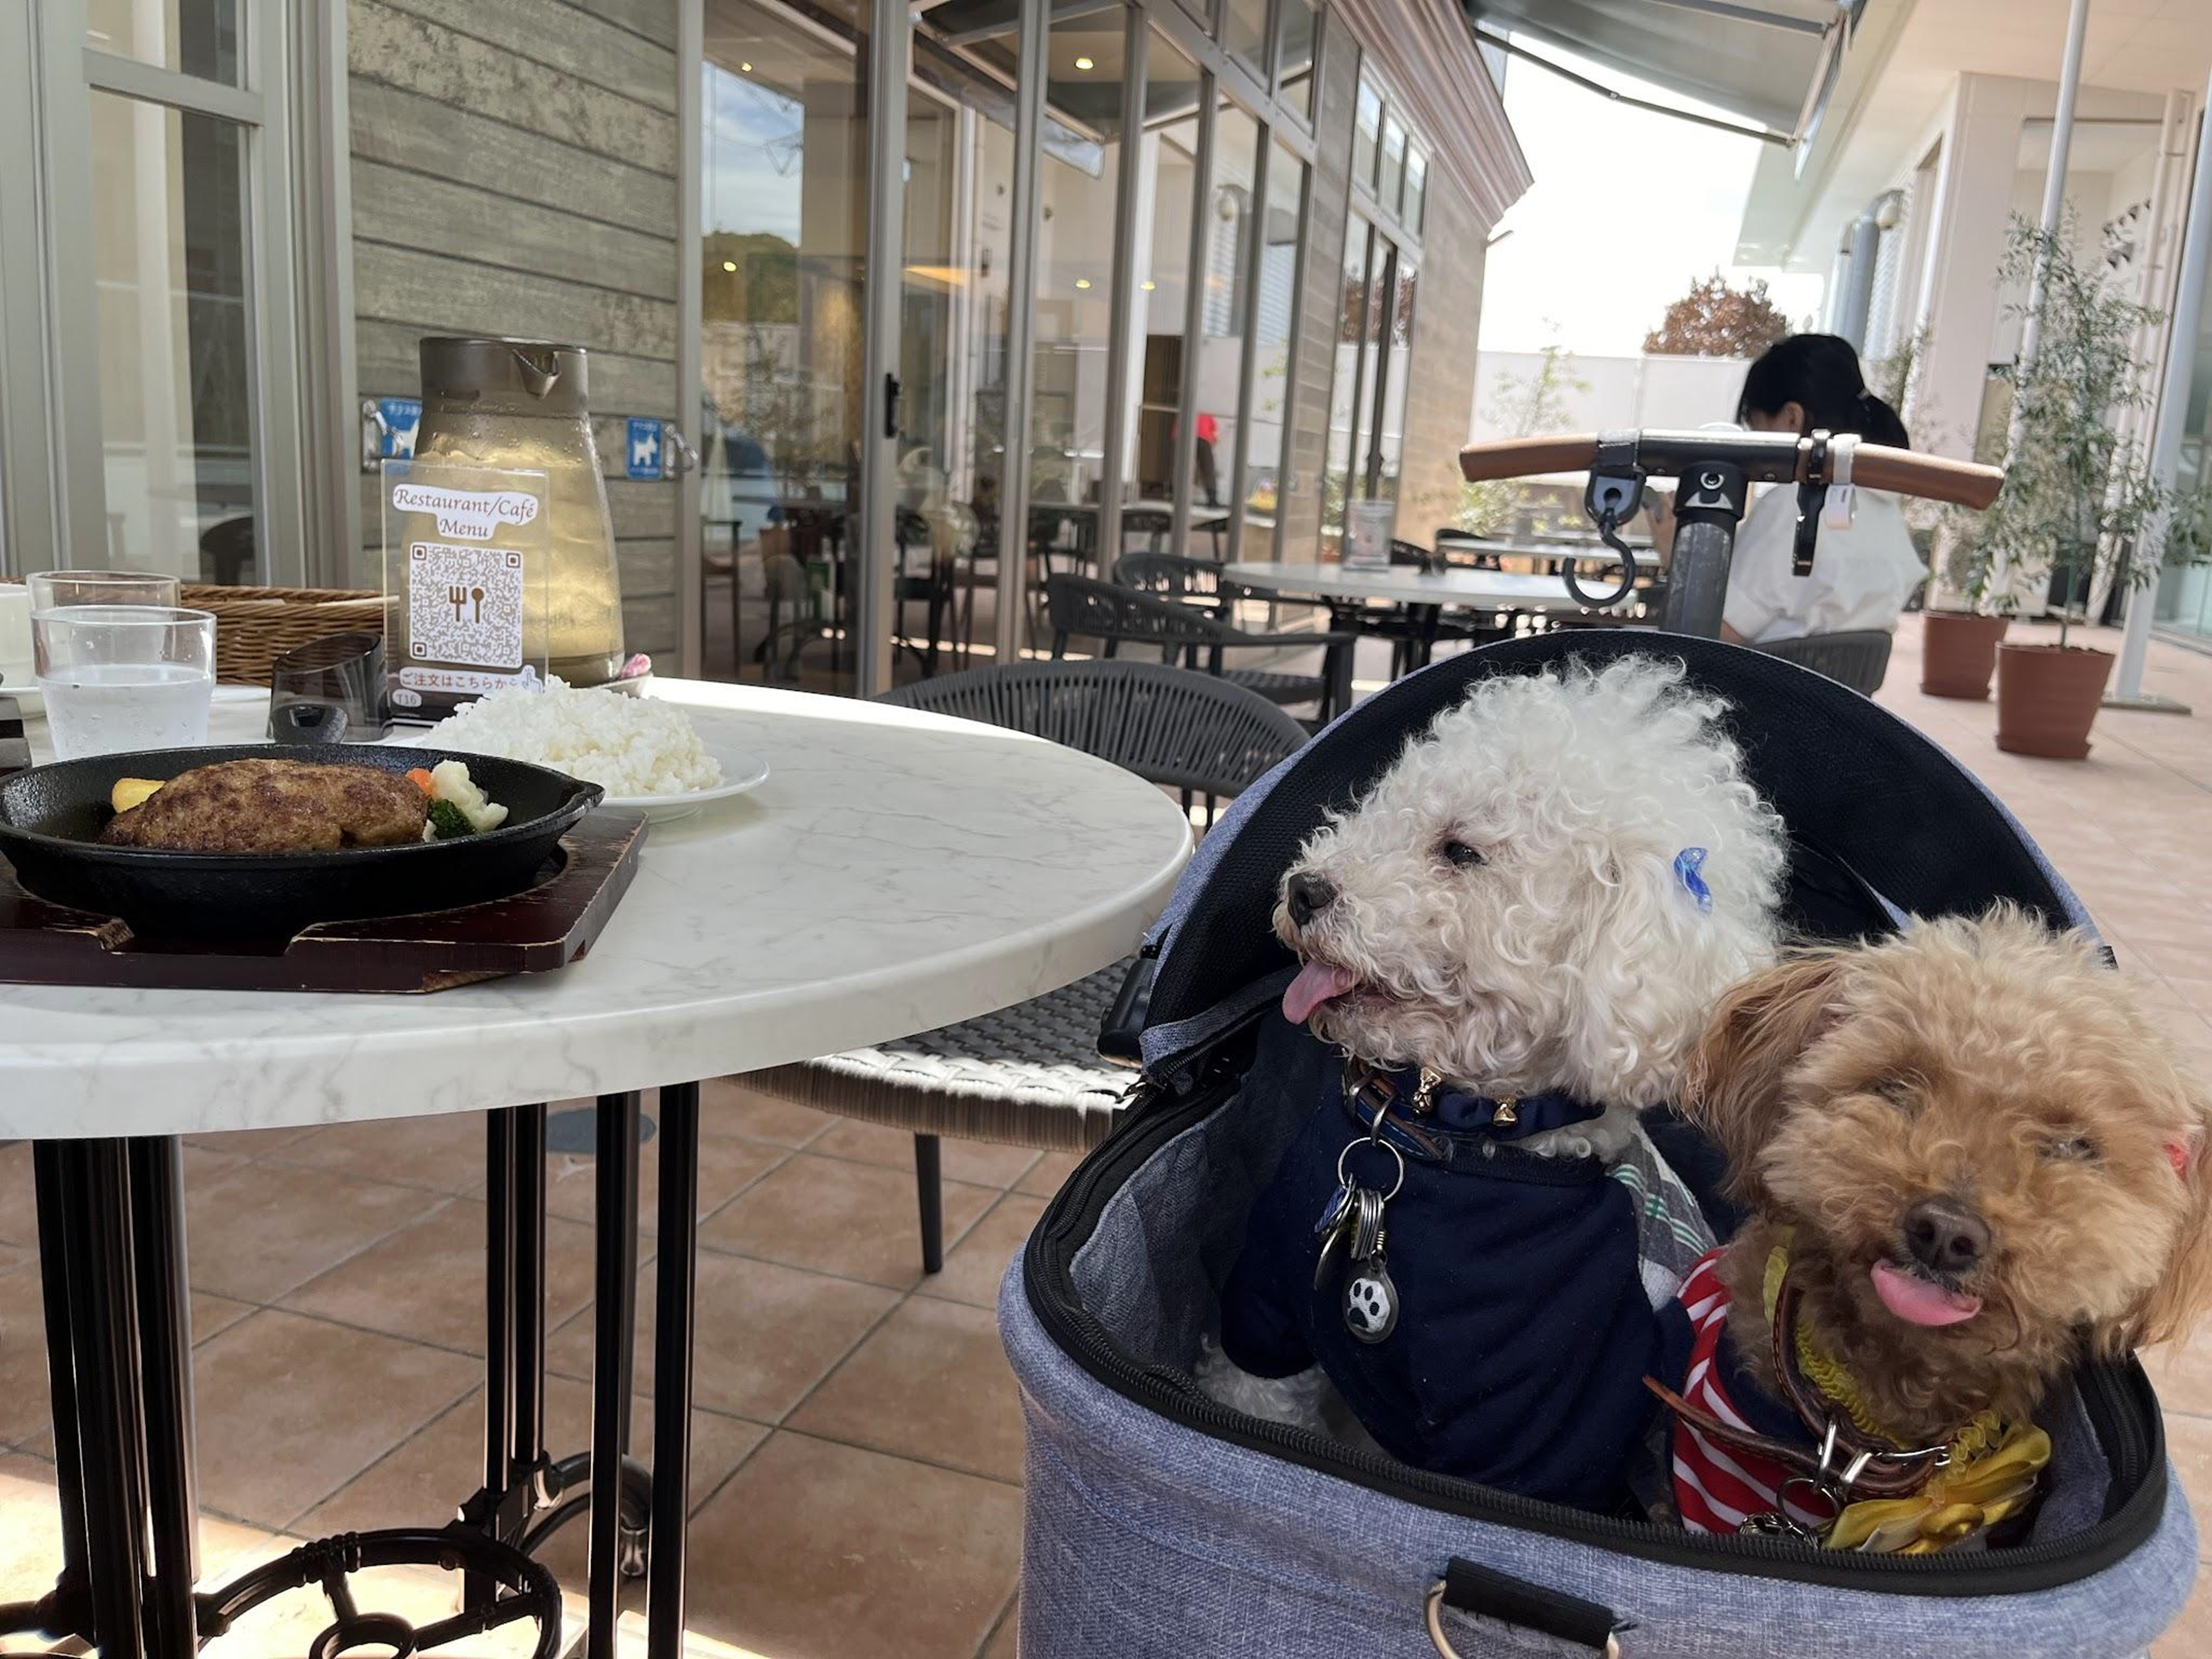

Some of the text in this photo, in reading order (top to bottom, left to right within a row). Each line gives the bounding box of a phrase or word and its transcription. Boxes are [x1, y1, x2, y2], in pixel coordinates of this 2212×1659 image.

[395, 488, 534, 524] Restaurant/Café
[439, 518, 488, 538] Menu
[397, 693, 416, 705] T16
